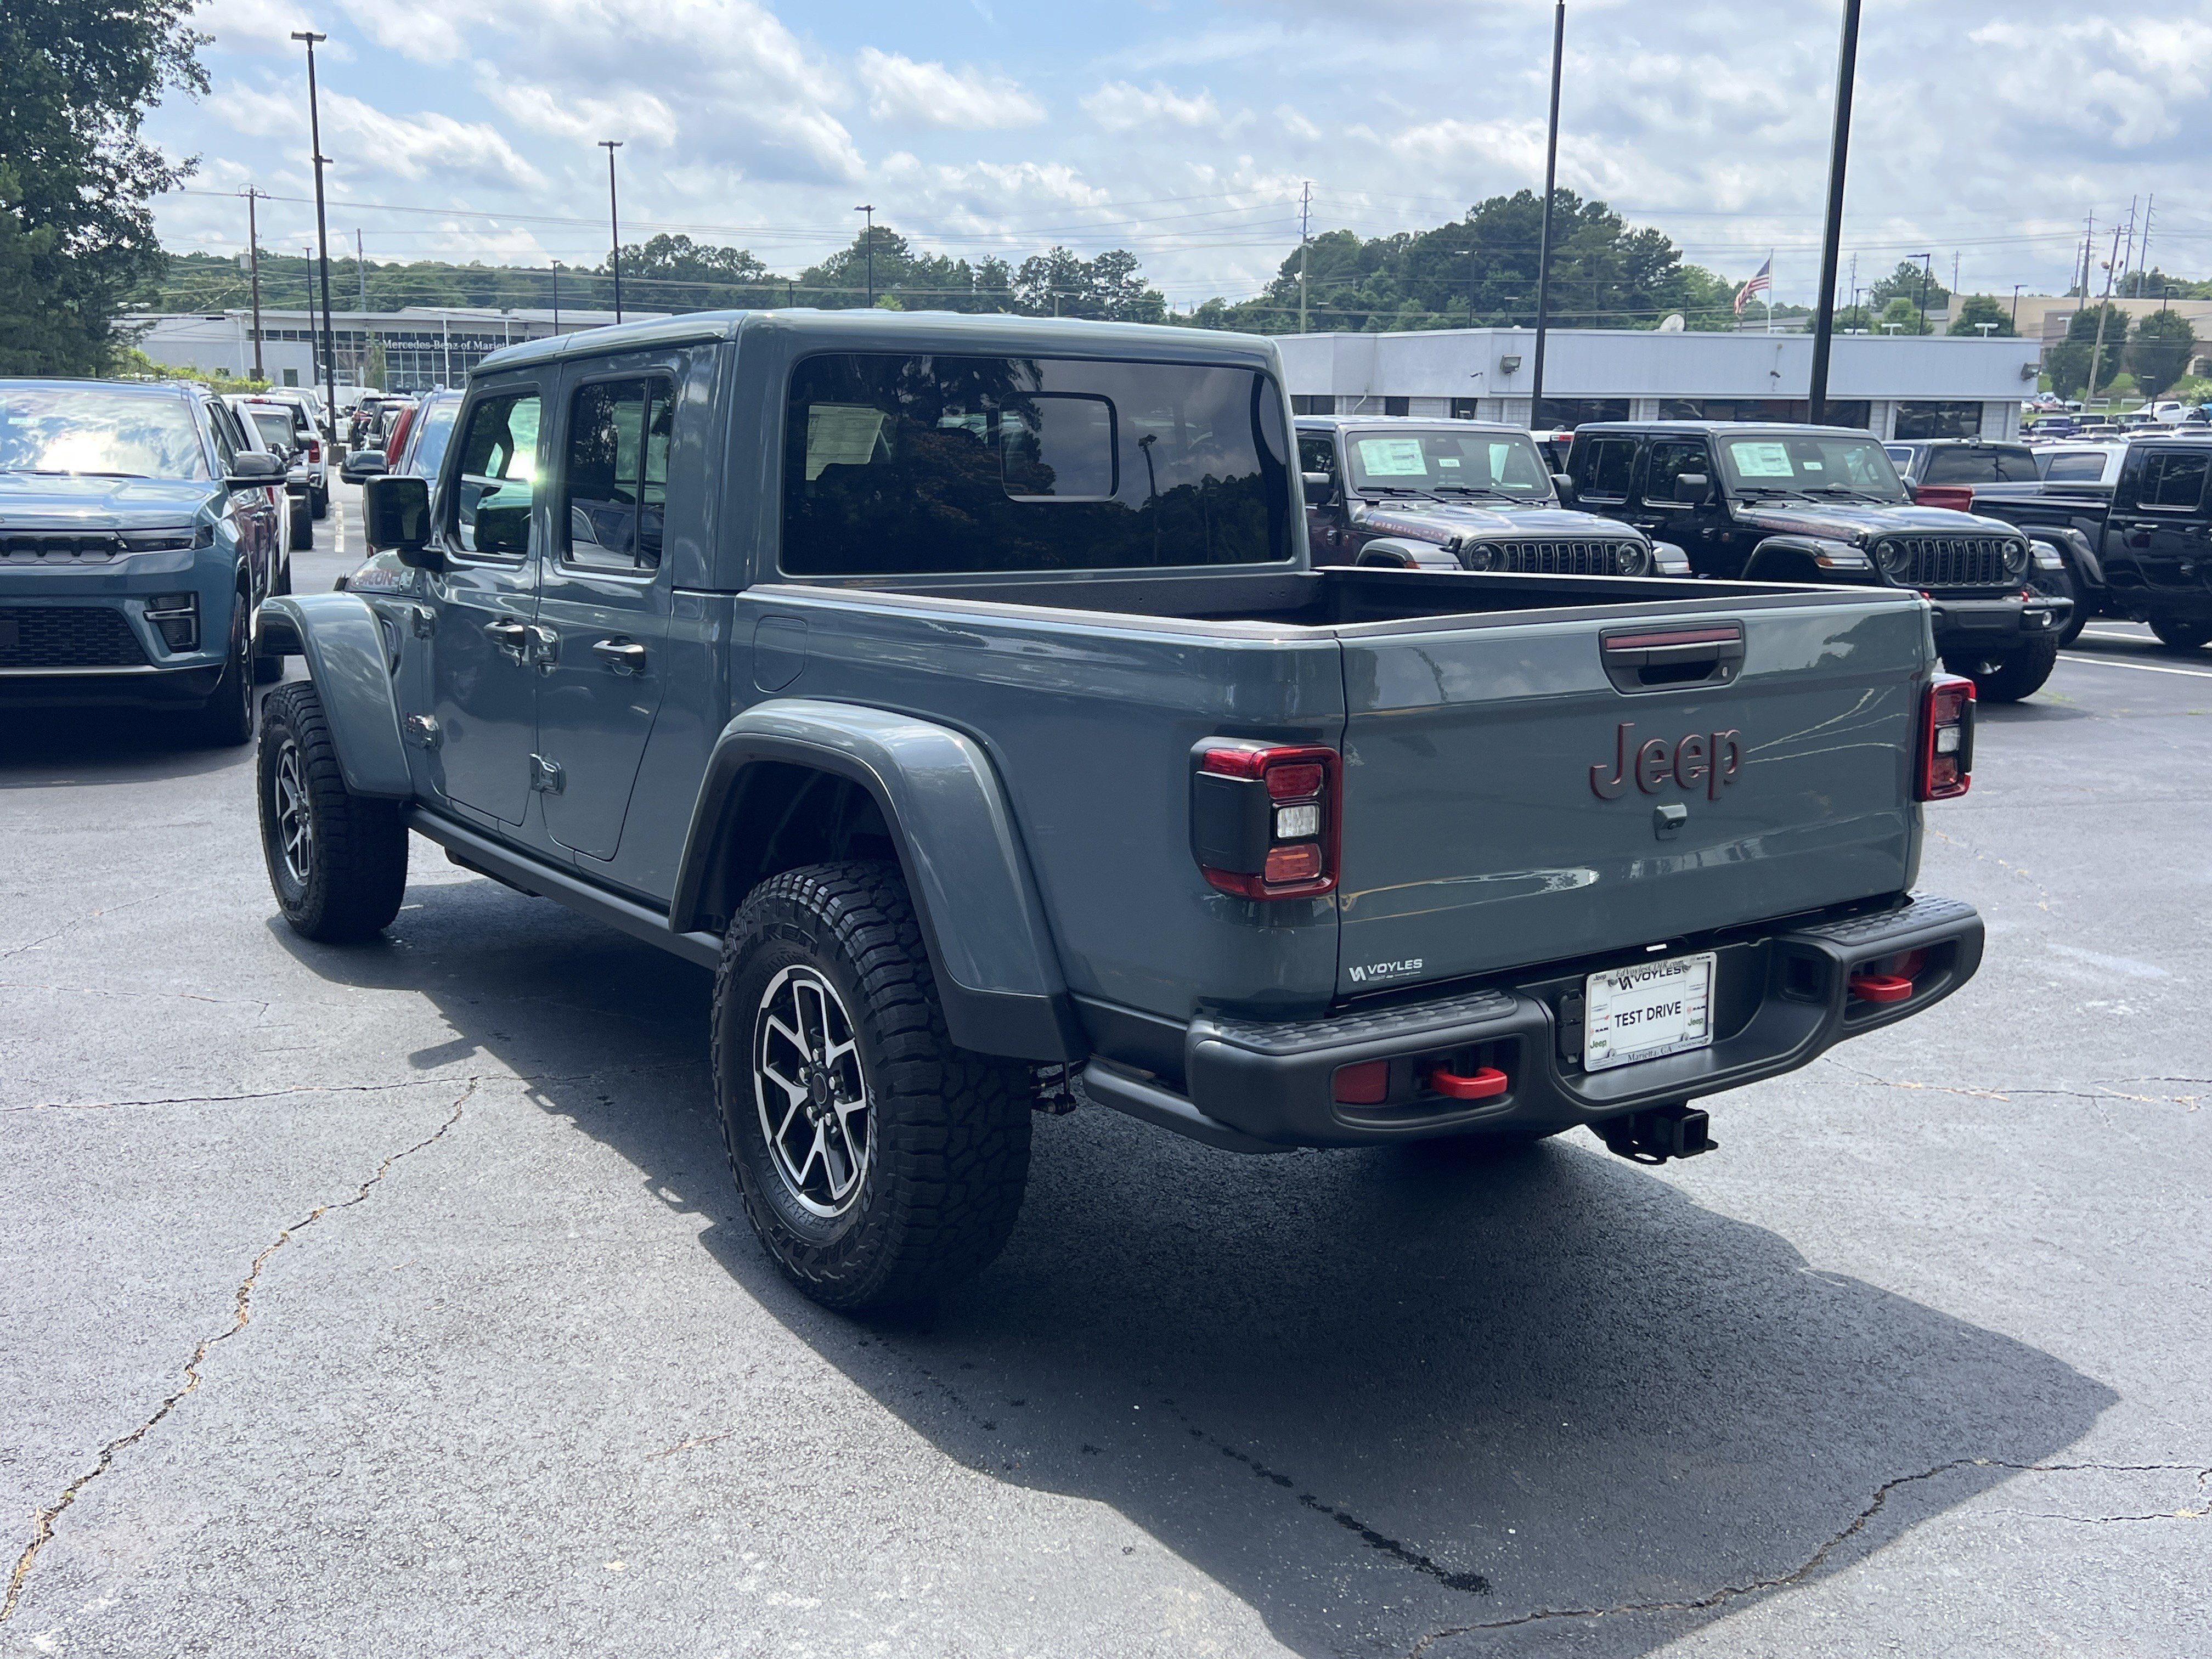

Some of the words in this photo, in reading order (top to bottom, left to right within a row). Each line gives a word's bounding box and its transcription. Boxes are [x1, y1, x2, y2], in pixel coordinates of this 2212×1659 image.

[382, 339, 458, 349] Mercedes-Benz
[461, 339, 470, 349] of
[1590, 722, 1741, 800] Jeep
[1367, 958, 1423, 974] VOYLES
[1635, 966, 1681, 982] VOYLES
[1615, 1009, 1643, 1028] TEST
[1647, 1001, 1681, 1021] DRIVE
[1688, 1018, 1703, 1026] Jeep
[1590, 1040, 1607, 1048] Jeep
